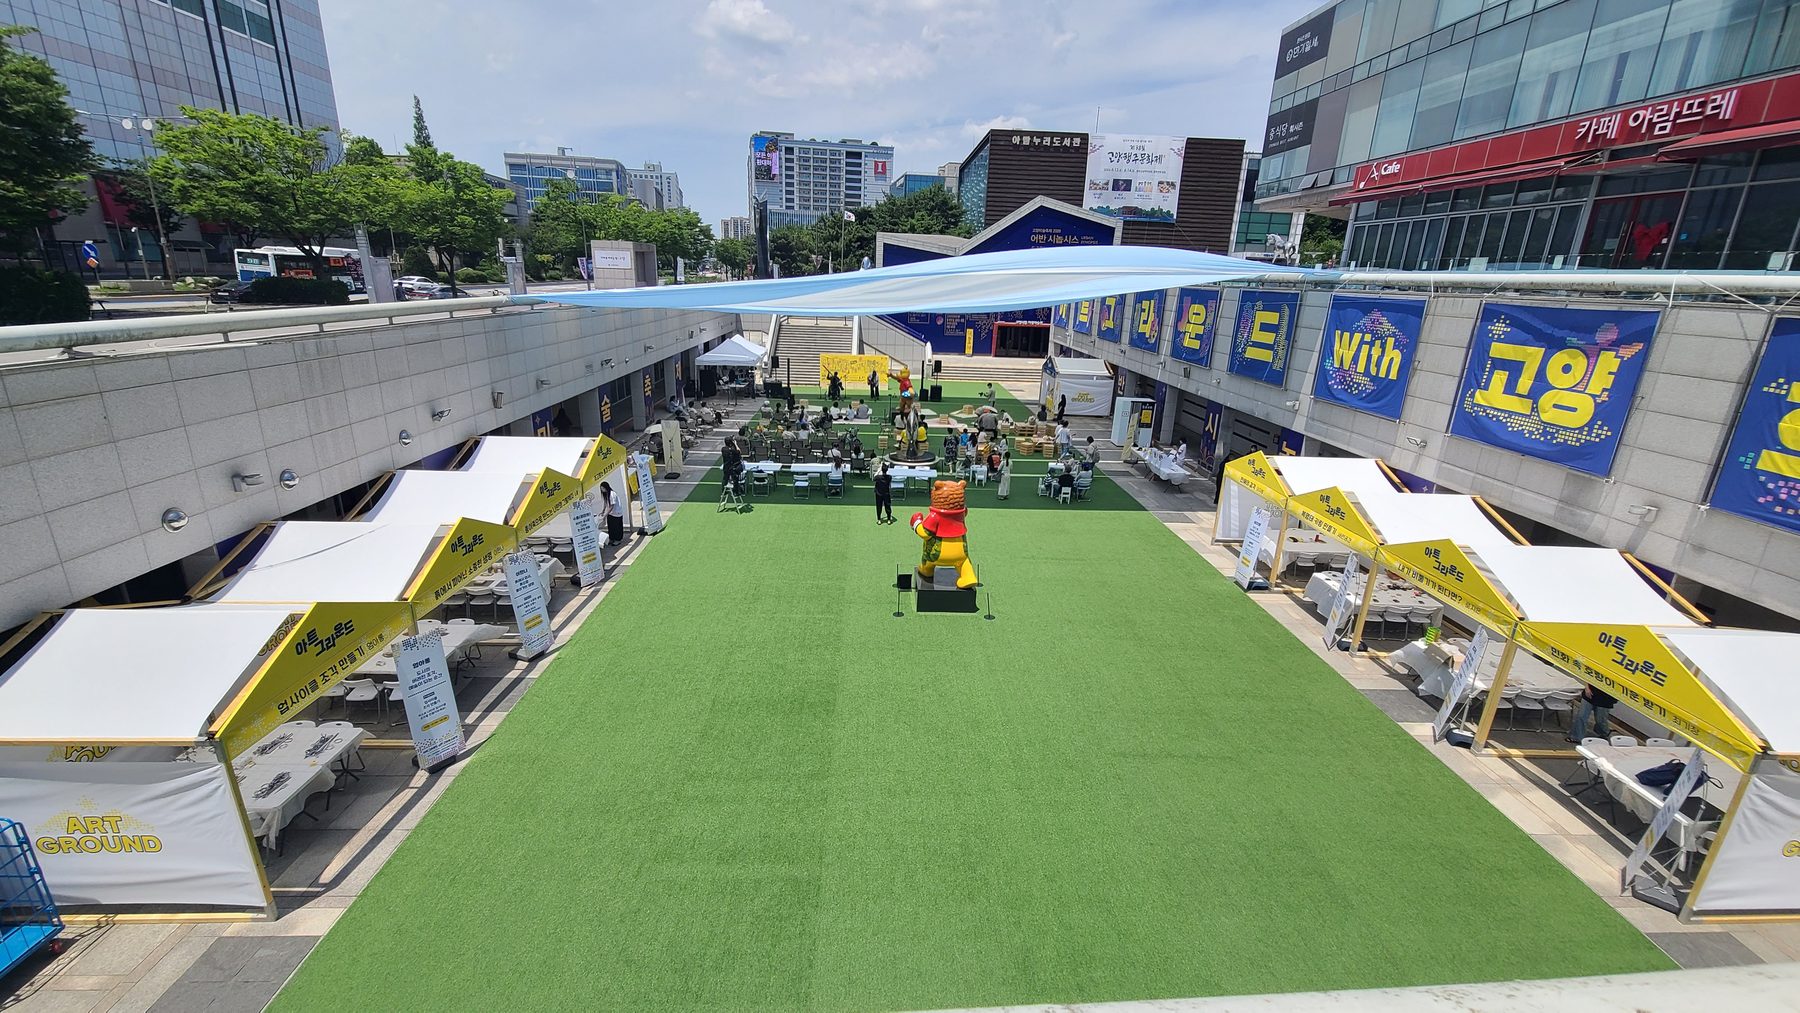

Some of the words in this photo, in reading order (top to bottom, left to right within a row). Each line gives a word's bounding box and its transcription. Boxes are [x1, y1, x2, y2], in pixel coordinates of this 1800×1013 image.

[1575, 111, 1620, 144] 카페
[1628, 89, 1739, 135] 아람뜨레
[1011, 135, 1082, 148] 아람누리도서관
[1380, 161, 1401, 177] Cafe
[1030, 234, 1047, 244] 어반
[1047, 234, 1080, 244] 시놉시스
[1183, 303, 1207, 350] 운
[1244, 310, 1280, 363] 드
[1333, 329, 1404, 381] With
[1473, 342, 1625, 428] 고양
[1205, 412, 1219, 441] 시
[1319, 494, 1331, 504] 아트
[1324, 504, 1346, 521] 그라운드
[450, 535, 465, 553] 아트
[461, 533, 485, 557] 그라운드
[1424, 546, 1441, 560] 아트
[1397, 563, 1412, 577] 내가
[1437, 584, 1463, 604] 된다면?
[1432, 559, 1465, 583] 그라운드
[294, 627, 320, 656] 아트
[314, 619, 355, 658] 그라운드
[1598, 631, 1628, 652] 아트
[276, 680, 320, 716] 업사이클
[319, 665, 339, 686] 조각
[337, 645, 365, 668] 만들기
[1611, 651, 1668, 687] 그라운드
[1550, 646, 1570, 665] 민화
[1572, 657, 1584, 672] 속
[1583, 662, 1616, 688] 호랑이
[1618, 680, 1641, 703] 기운
[1642, 695, 1667, 719] 받기
[66, 815, 123, 835] ART
[36, 834, 163, 854] GROUND
